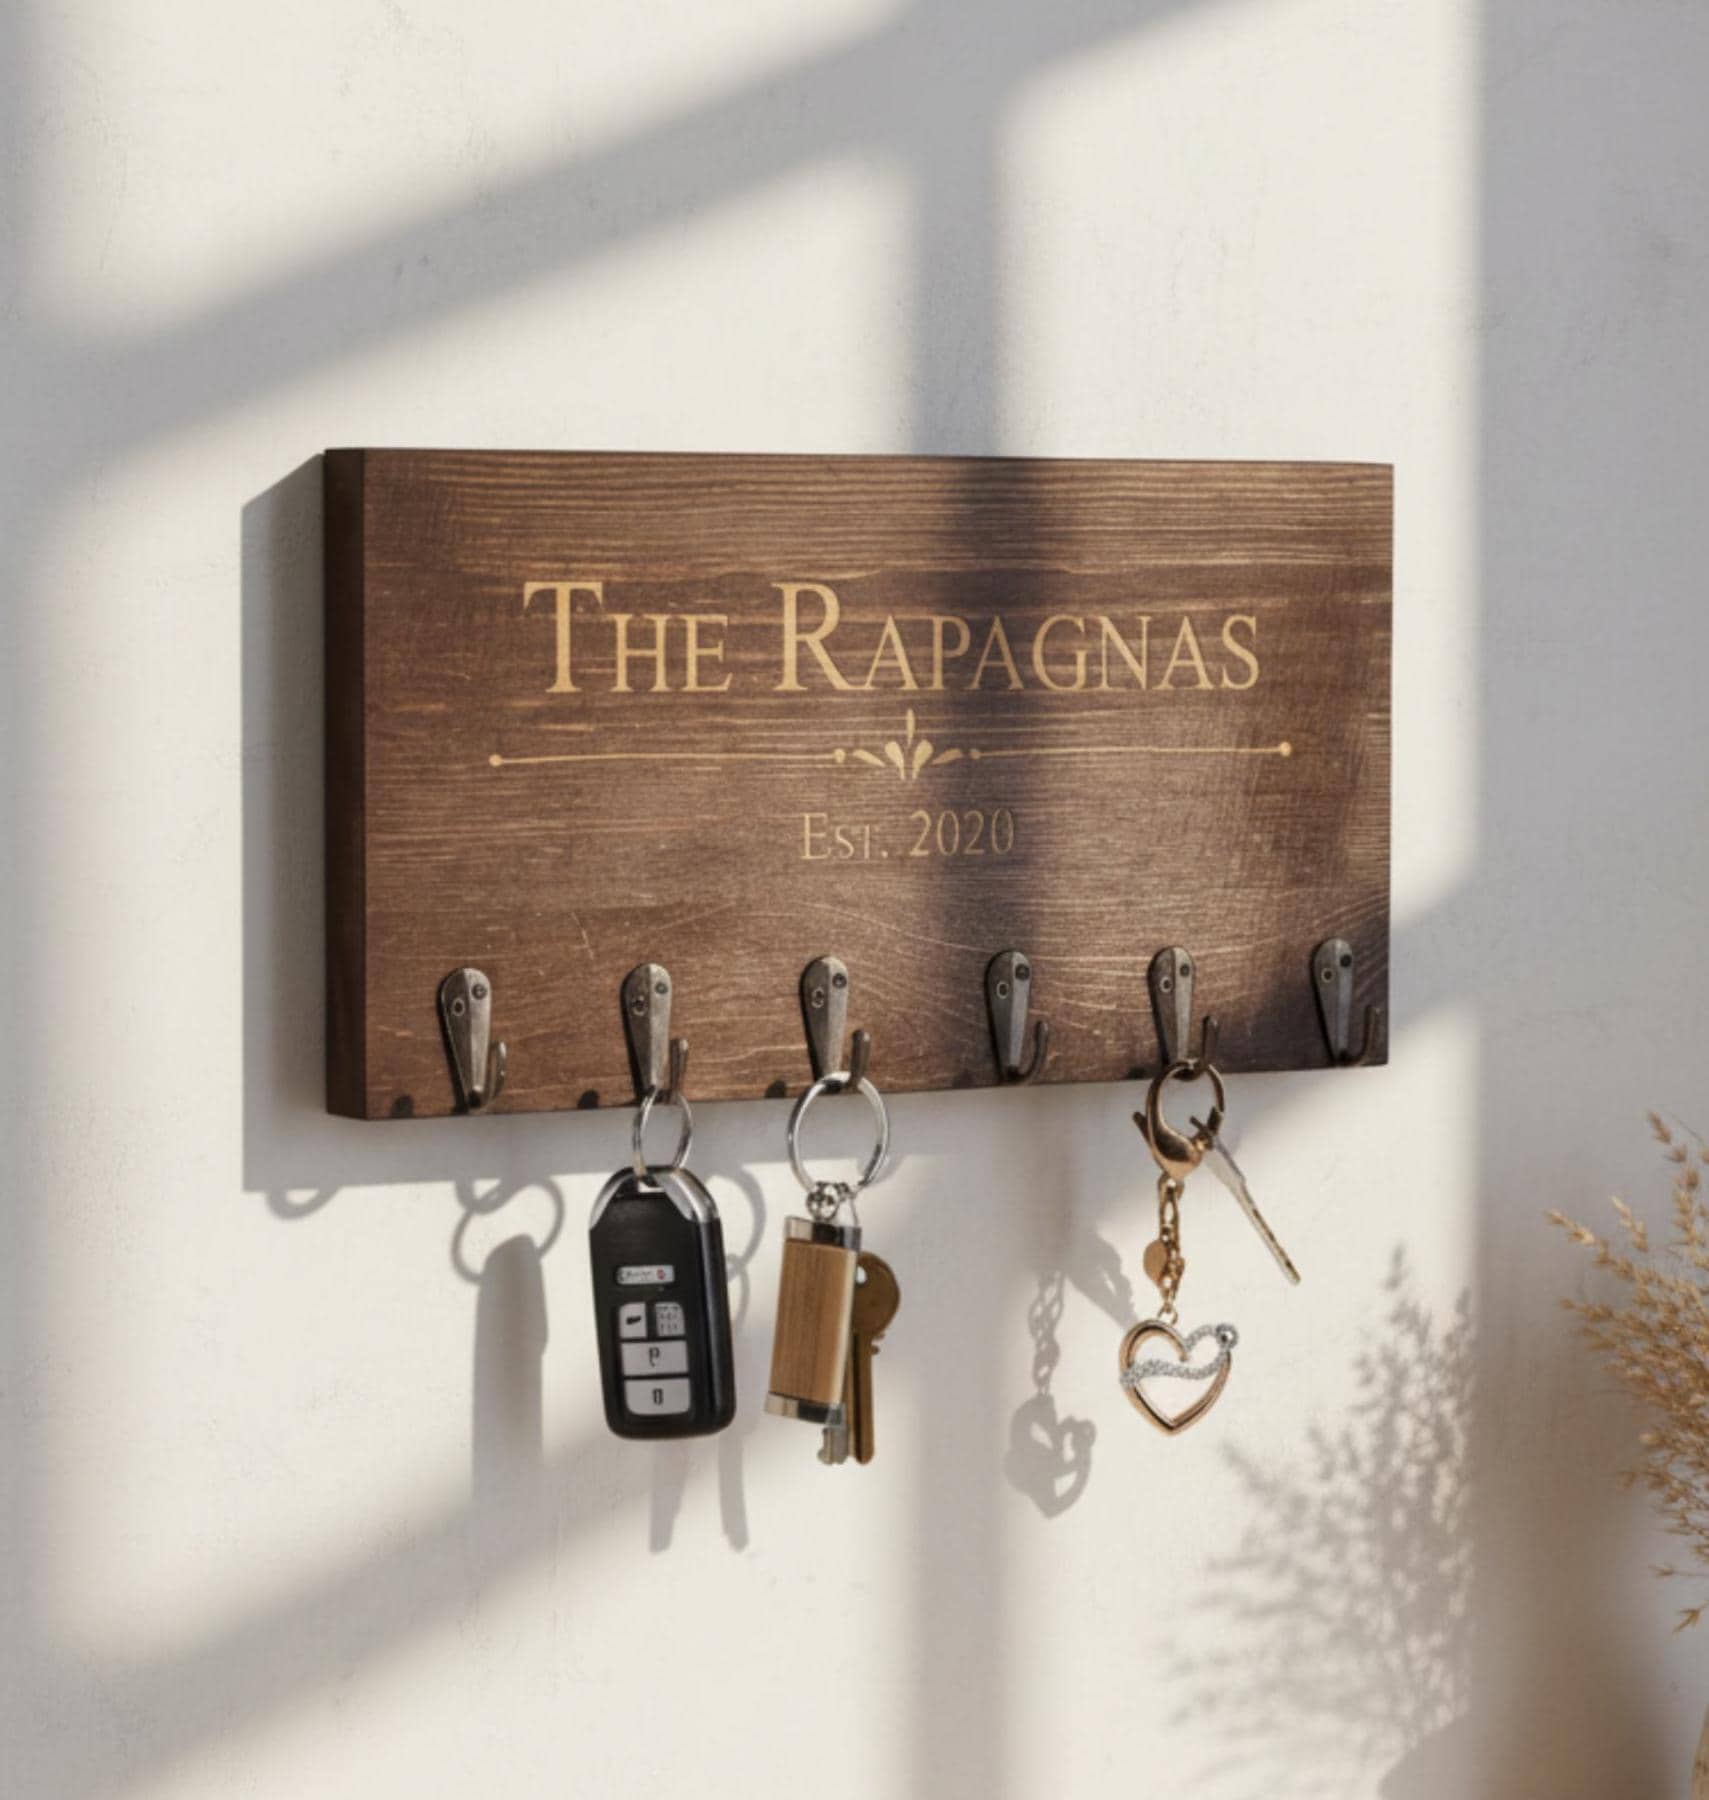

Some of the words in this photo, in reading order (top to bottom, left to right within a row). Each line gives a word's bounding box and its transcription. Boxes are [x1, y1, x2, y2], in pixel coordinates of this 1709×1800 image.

[523, 580, 733, 694] THE
[771, 580, 1261, 693] RAPAGNAS
[909, 808, 1015, 859] 2020
